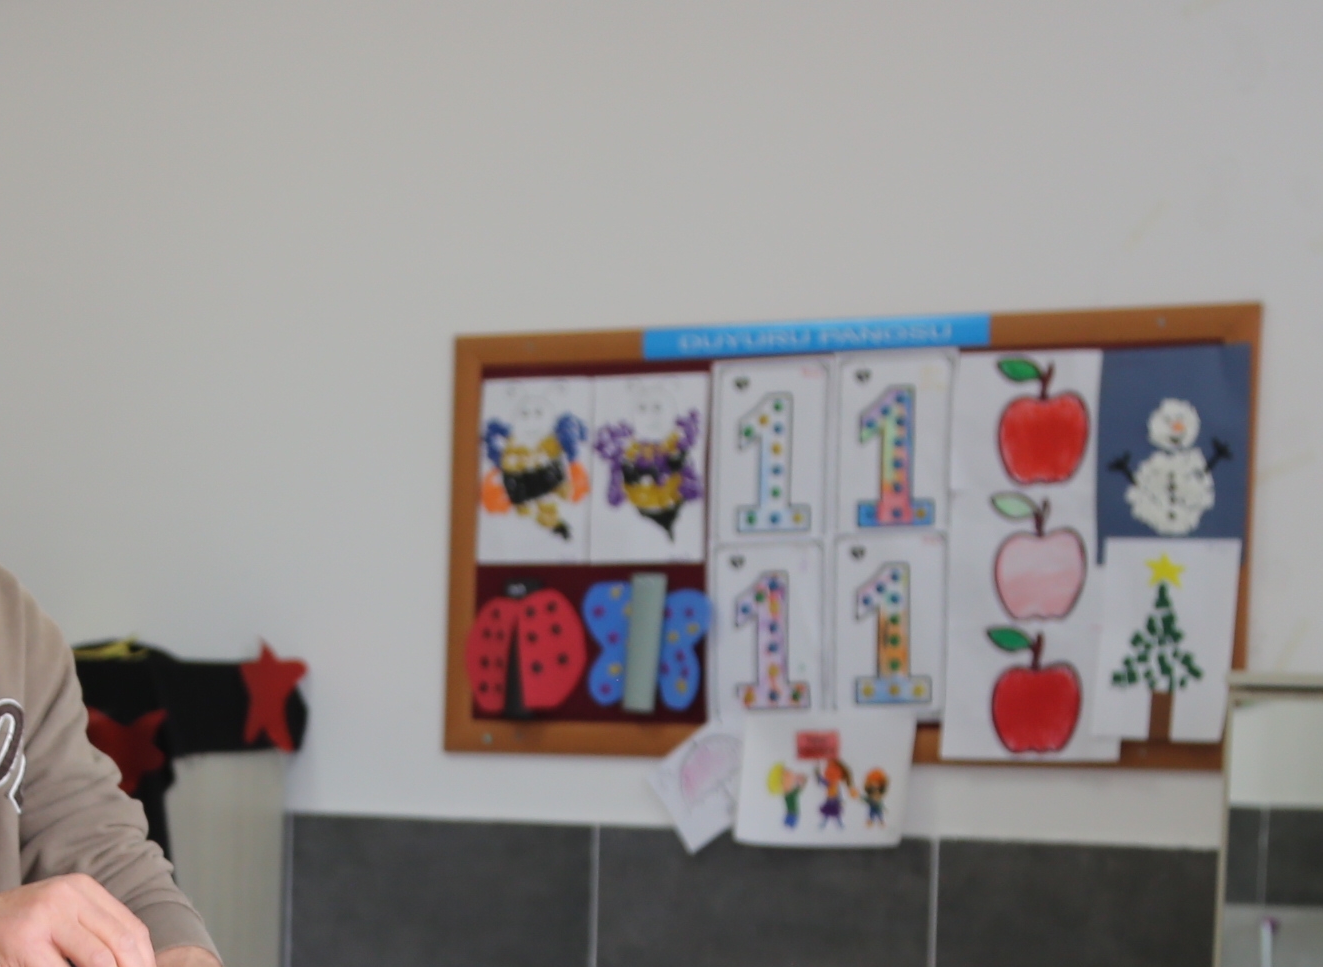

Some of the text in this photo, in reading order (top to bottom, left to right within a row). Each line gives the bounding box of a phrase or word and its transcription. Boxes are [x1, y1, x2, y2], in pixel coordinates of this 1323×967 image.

[679, 321, 953, 351] DUYURU PANOSU
[737, 392, 811, 532] 1
[858, 385, 935, 527] 1
[735, 570, 811, 709] 1
[855, 562, 932, 704] 1
